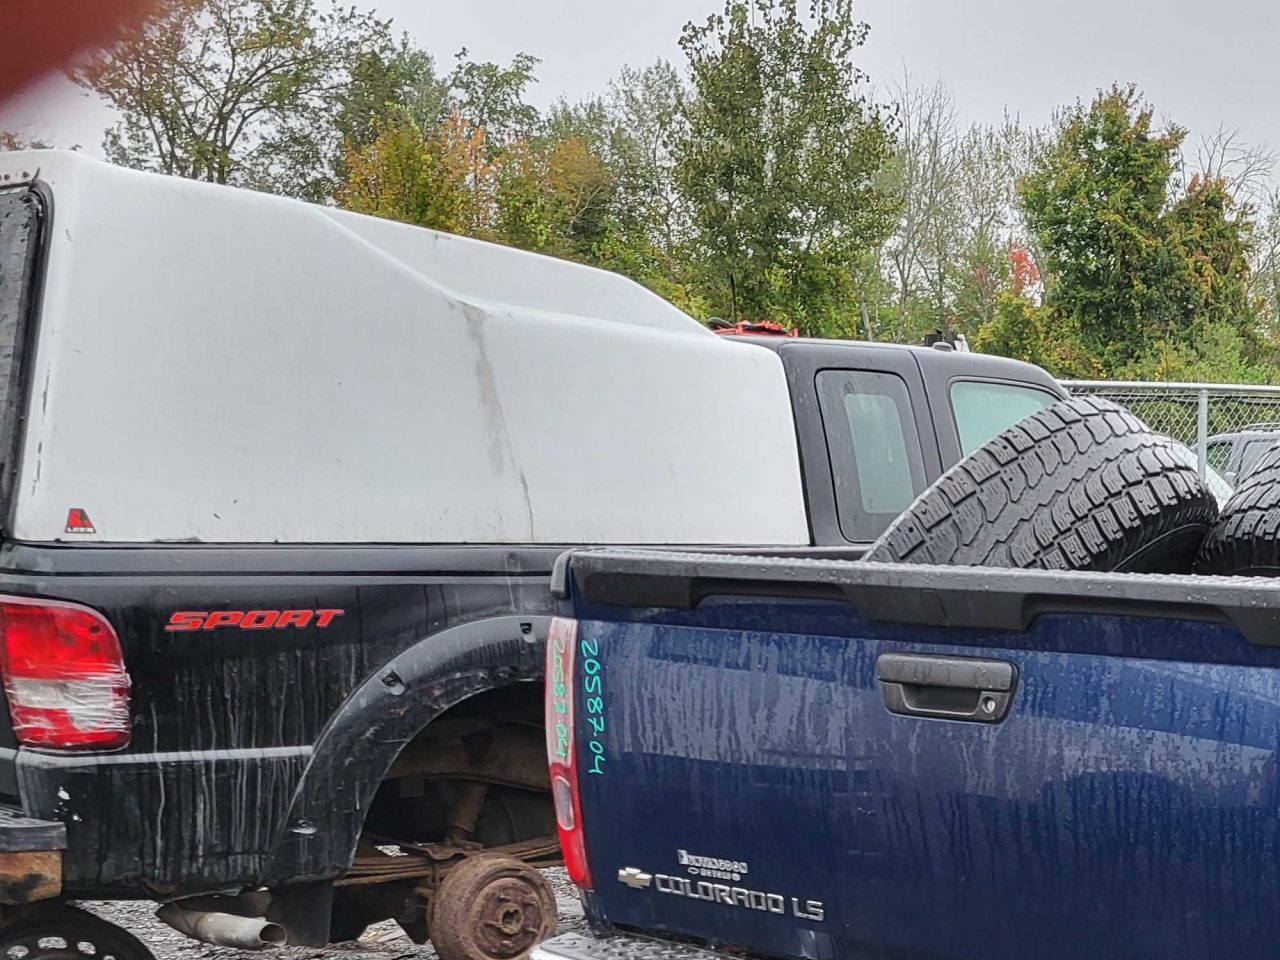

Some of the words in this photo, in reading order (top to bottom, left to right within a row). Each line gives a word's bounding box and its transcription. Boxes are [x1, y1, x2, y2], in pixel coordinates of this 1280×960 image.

[164, 609, 345, 632] SPORT
[655, 874, 785, 914] COLORADO
[791, 897, 825, 922] LS
